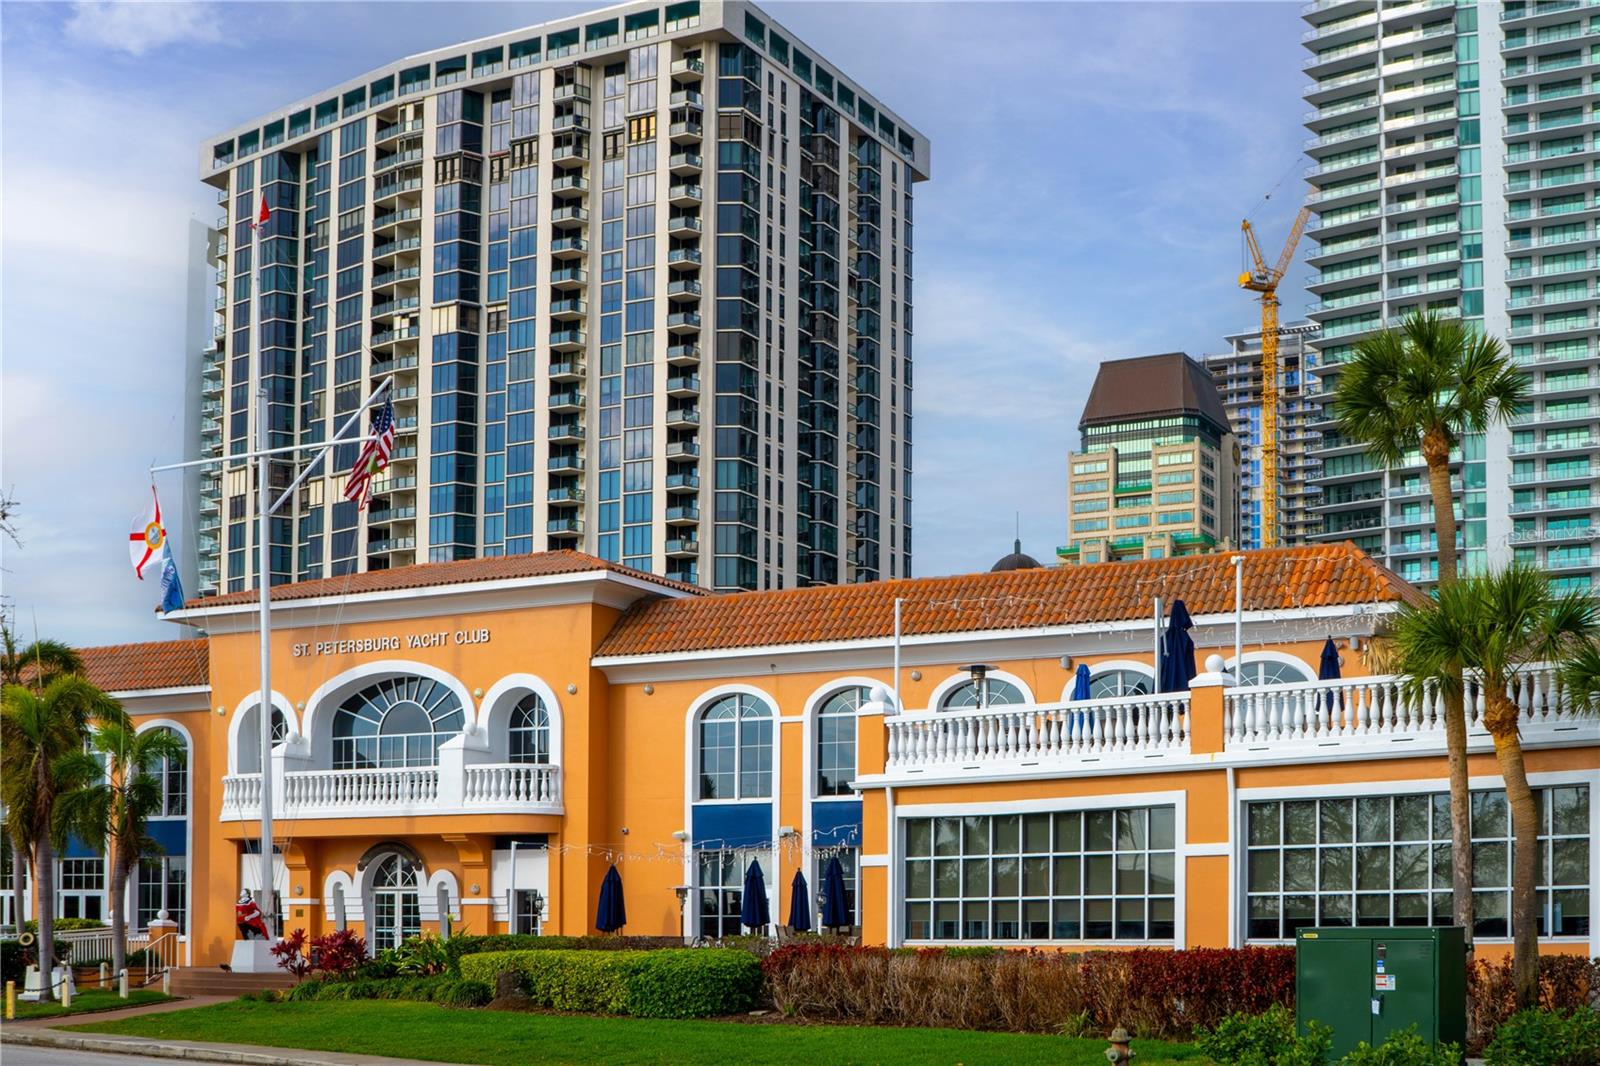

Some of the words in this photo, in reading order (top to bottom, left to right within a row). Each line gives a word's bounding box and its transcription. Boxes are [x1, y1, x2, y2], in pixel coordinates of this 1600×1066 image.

[292, 643, 311, 657] ST.
[315, 636, 400, 655] PETERSBURG
[406, 632, 448, 648] YACHT
[454, 628, 490, 644] CLUB
